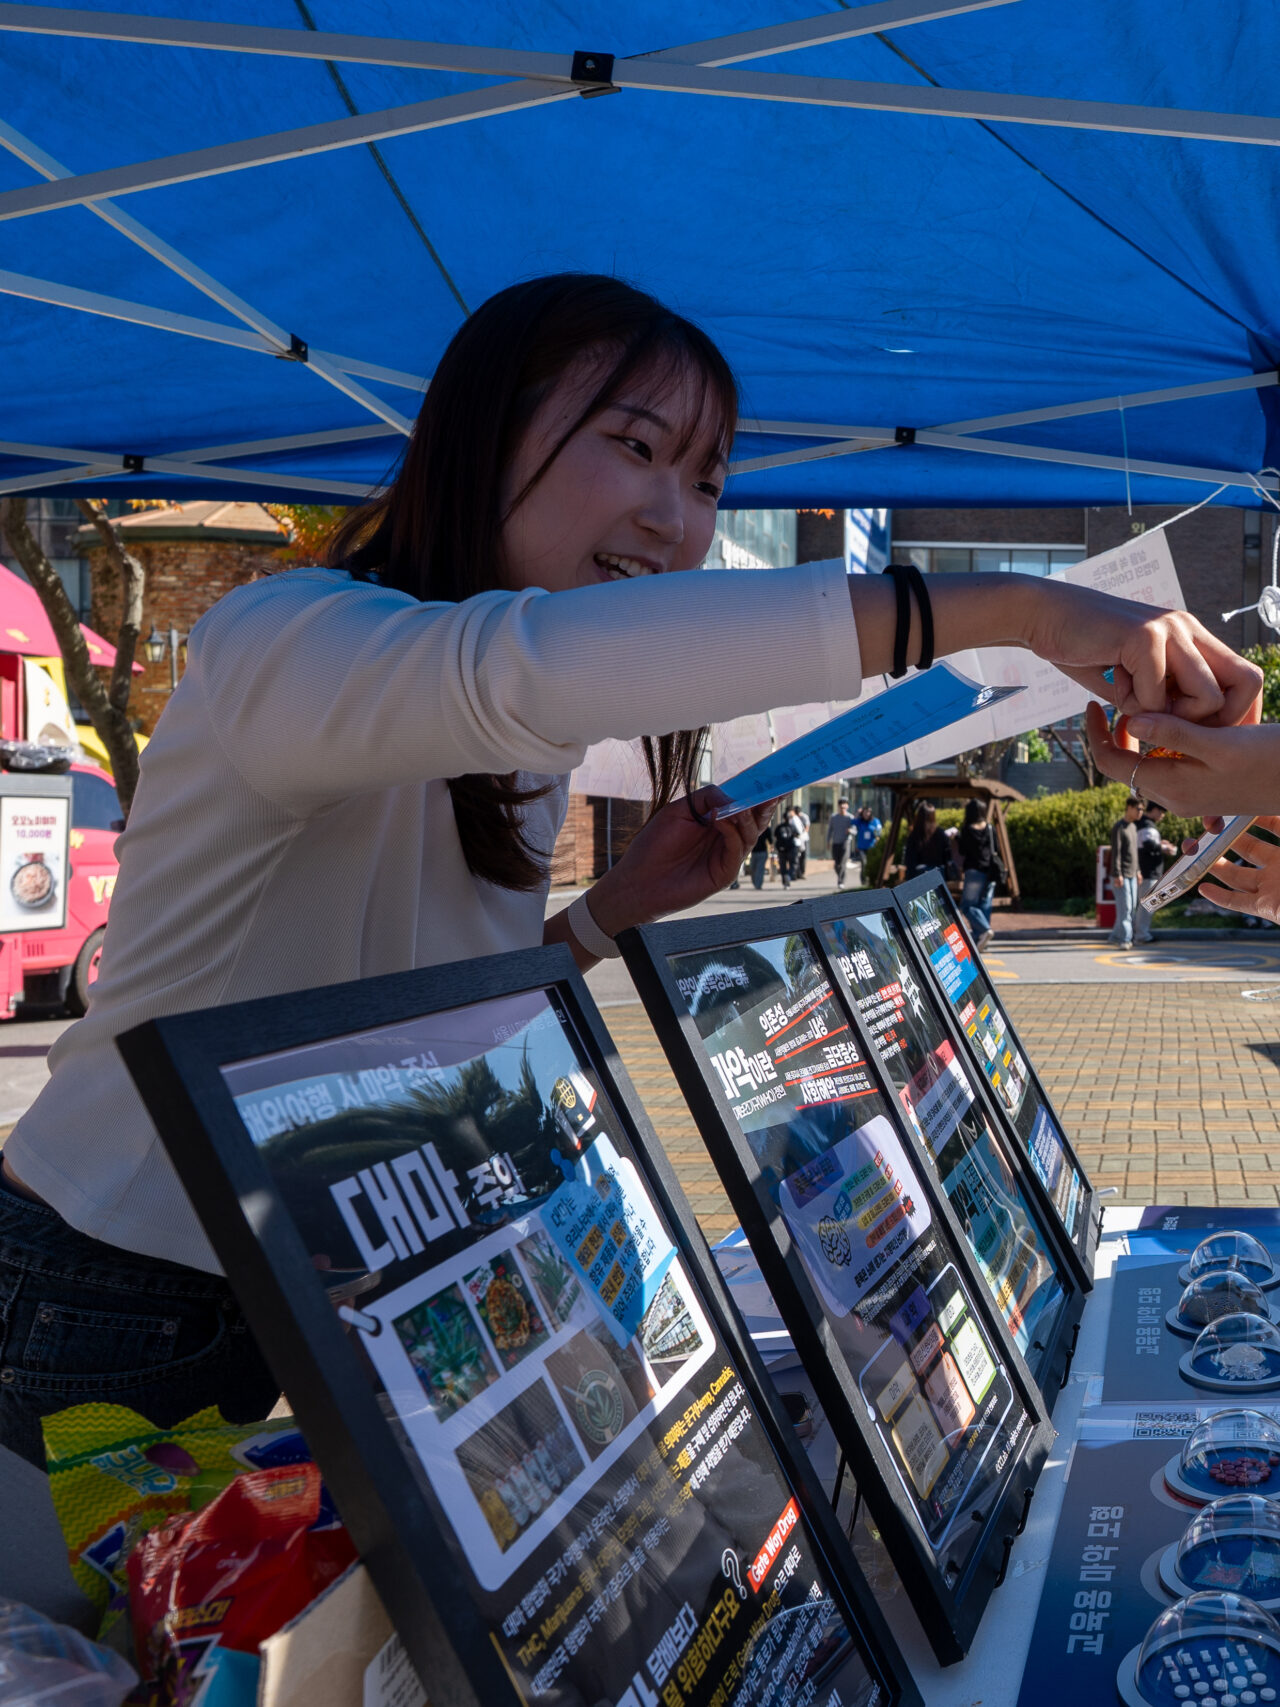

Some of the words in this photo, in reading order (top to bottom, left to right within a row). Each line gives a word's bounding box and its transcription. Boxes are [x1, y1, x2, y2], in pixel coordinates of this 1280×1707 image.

[853, 950, 875, 982] 처벌
[808, 1015, 829, 1040] 내성
[823, 1041, 859, 1069] 금단증상
[340, 1080, 363, 1110] 시
[359, 1066, 407, 1100] 마약
[329, 1142, 471, 1273] 대마
[565, 1194, 603, 1248] 우리나라에서는
[588, 1264, 606, 1287] 함유
[1136, 1305, 1161, 1325] 마약
[1137, 1287, 1162, 1304] 모형
[1135, 1326, 1161, 1356] 교육용
[502, 1606, 525, 1636] 대마
[546, 1559, 566, 1584] 국가
[591, 1504, 615, 1536] 온라인
[663, 1420, 687, 1448] 의미하는
[516, 1633, 544, 1665] THC,
[540, 1587, 582, 1637] Marijuana
[676, 1443, 695, 1468] 제품을
[691, 1430, 705, 1451] 구매
[723, 1396, 732, 1412] 안
[1087, 1505, 1125, 1538] 모형
[751, 1548, 770, 1583] Gate
[764, 1526, 783, 1561] Way
[778, 1504, 796, 1539] Drug
[783, 1545, 801, 1576] 대마로
[1079, 1544, 1119, 1582] 마약
[530, 1646, 568, 1695] 대한민국
[602, 1563, 632, 1603] 기준으로
[628, 1546, 645, 1571] 법을
[676, 1587, 742, 1692] 위험하다구요
[1066, 1590, 1112, 1656] 교육용
[646, 1601, 700, 1688] 담배보다
[755, 1634, 775, 1673] 통로가
